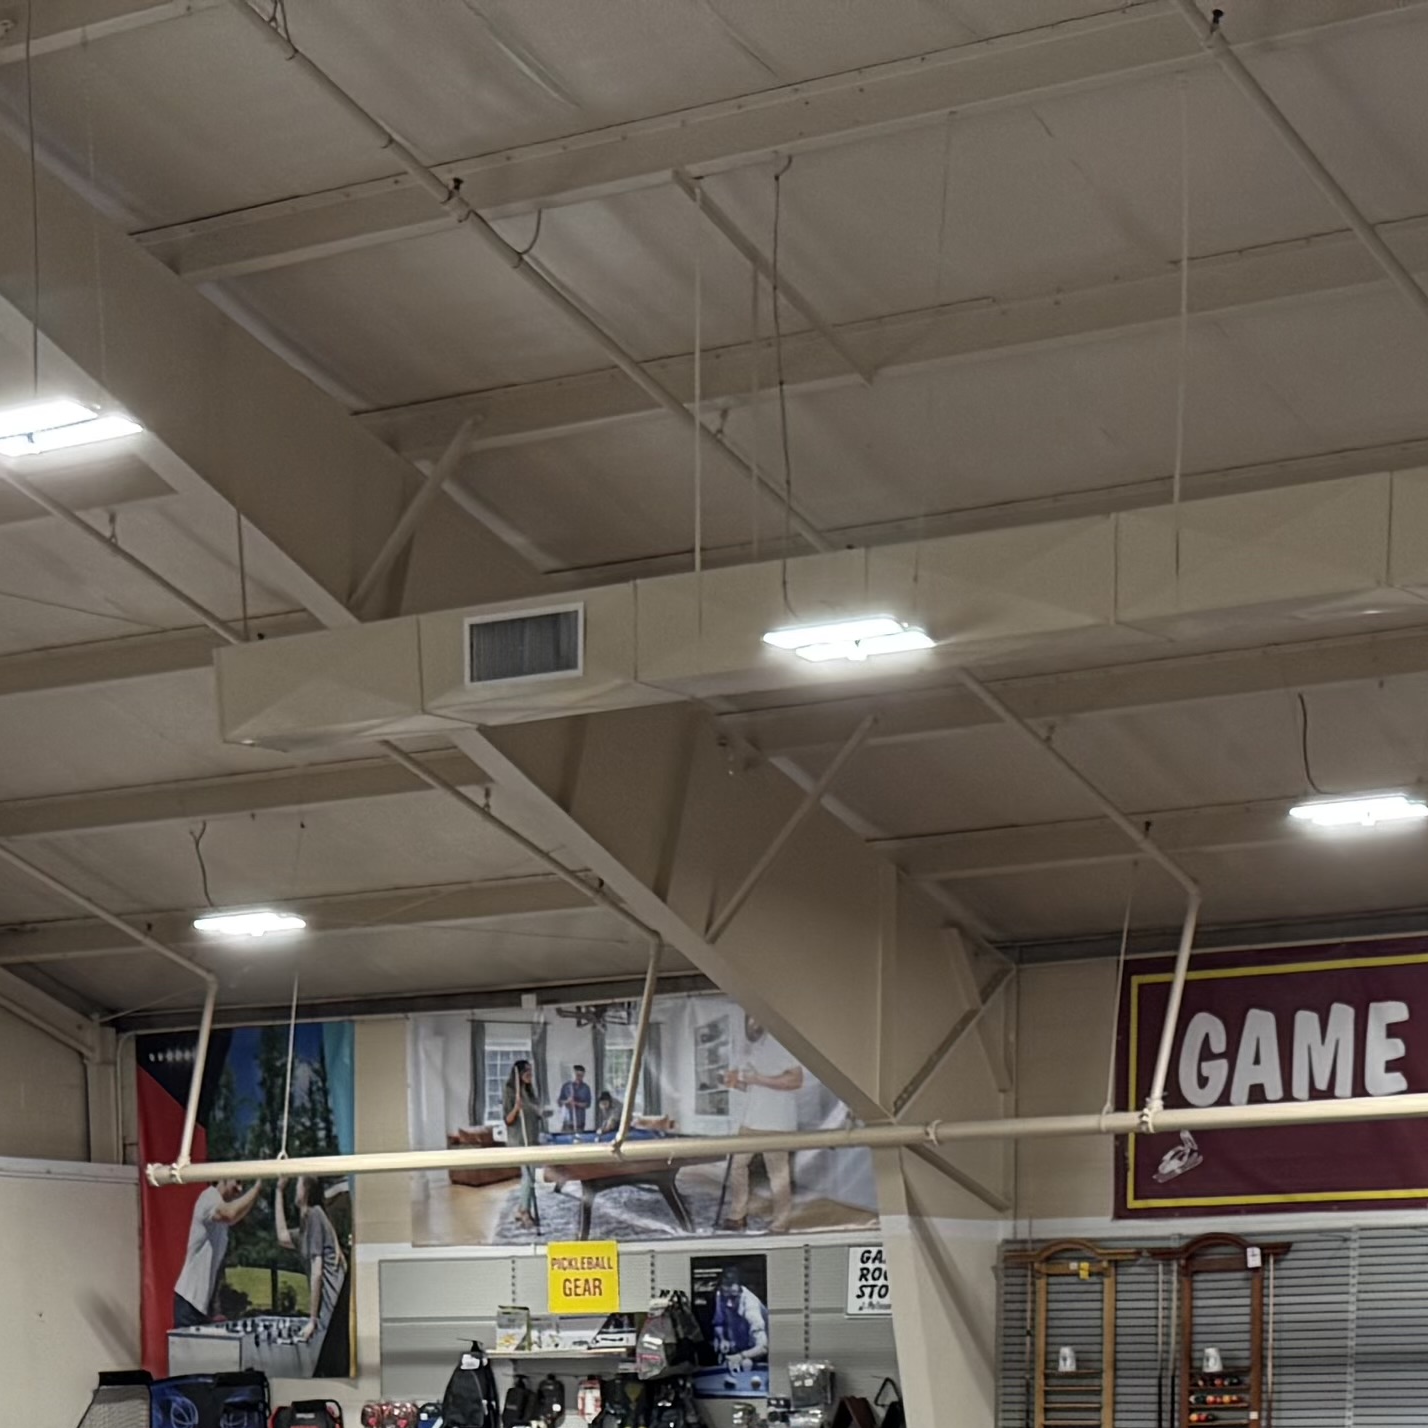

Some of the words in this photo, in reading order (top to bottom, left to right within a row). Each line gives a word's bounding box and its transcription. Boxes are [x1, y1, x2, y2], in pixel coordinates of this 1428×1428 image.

[1176, 1000, 1410, 1107] GAME
[550, 1255, 614, 1271] PICKLEBALL
[860, 1249, 886, 1265] GA
[562, 1278, 604, 1298] GEAR
[856, 1284, 889, 1299] STO
